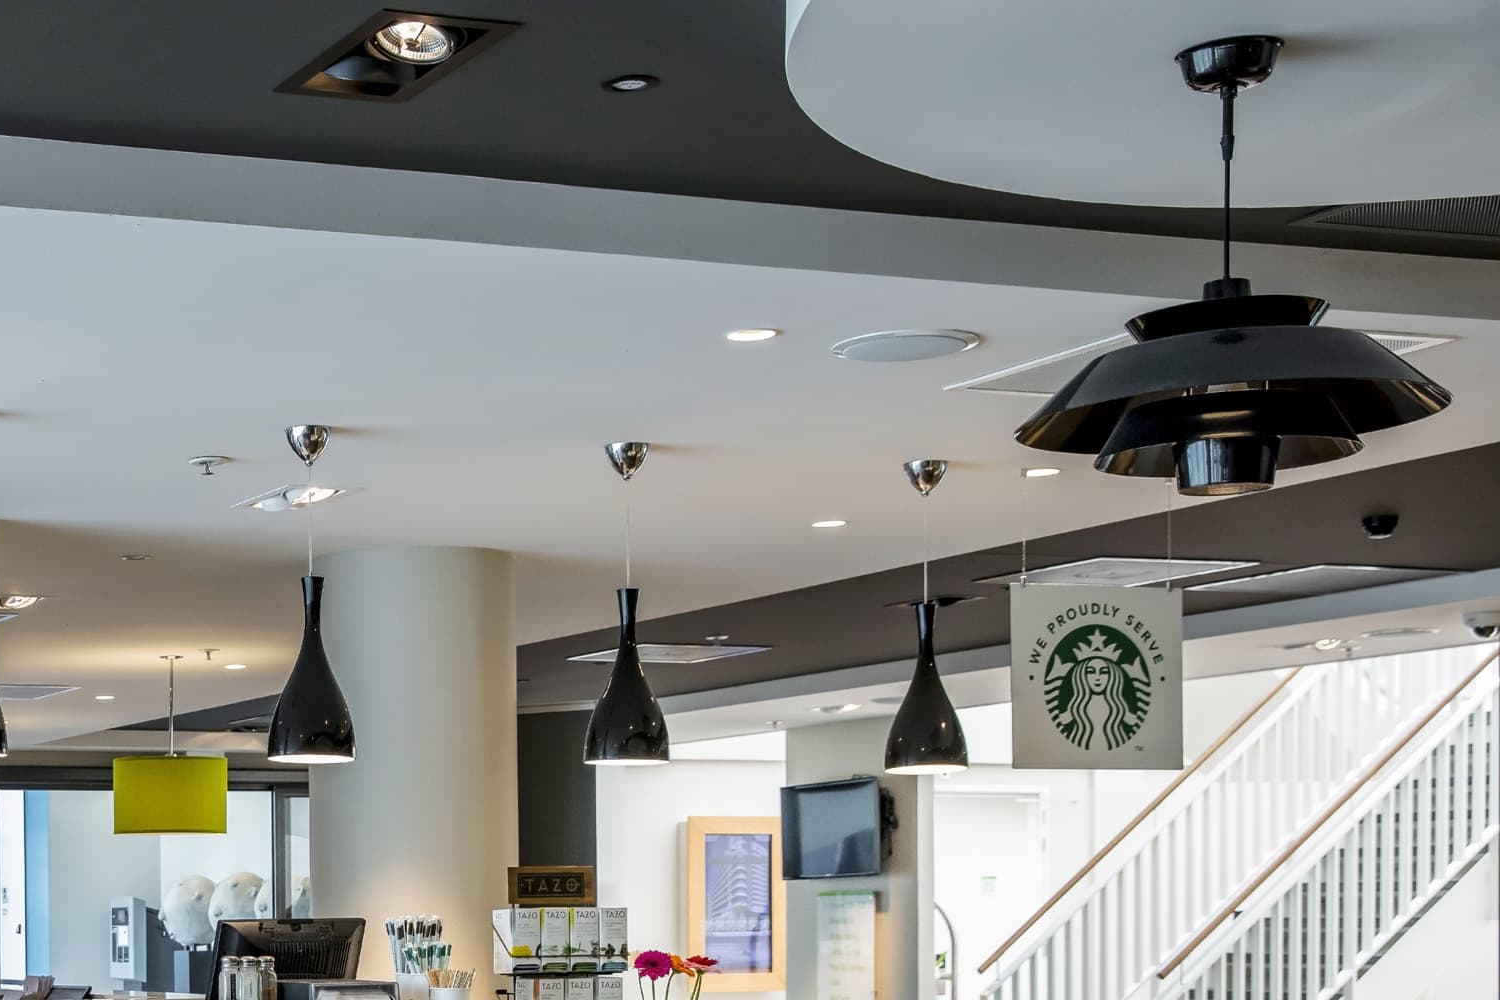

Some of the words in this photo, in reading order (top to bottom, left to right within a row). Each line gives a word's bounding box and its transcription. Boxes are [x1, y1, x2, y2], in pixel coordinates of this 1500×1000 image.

[1028, 636, 1048, 664] WE
[1047, 603, 1120, 634] PROUDLY
[1124, 614, 1164, 665] SERVE
[524, 879, 578, 892] TAZO
[518, 912, 538, 920] TAZO
[547, 911, 567, 919] TAZO
[576, 911, 596, 919] TAZO
[605, 910, 625, 918] TAZO
[570, 981, 591, 989] TAZO
[601, 981, 620, 989] TAZO
